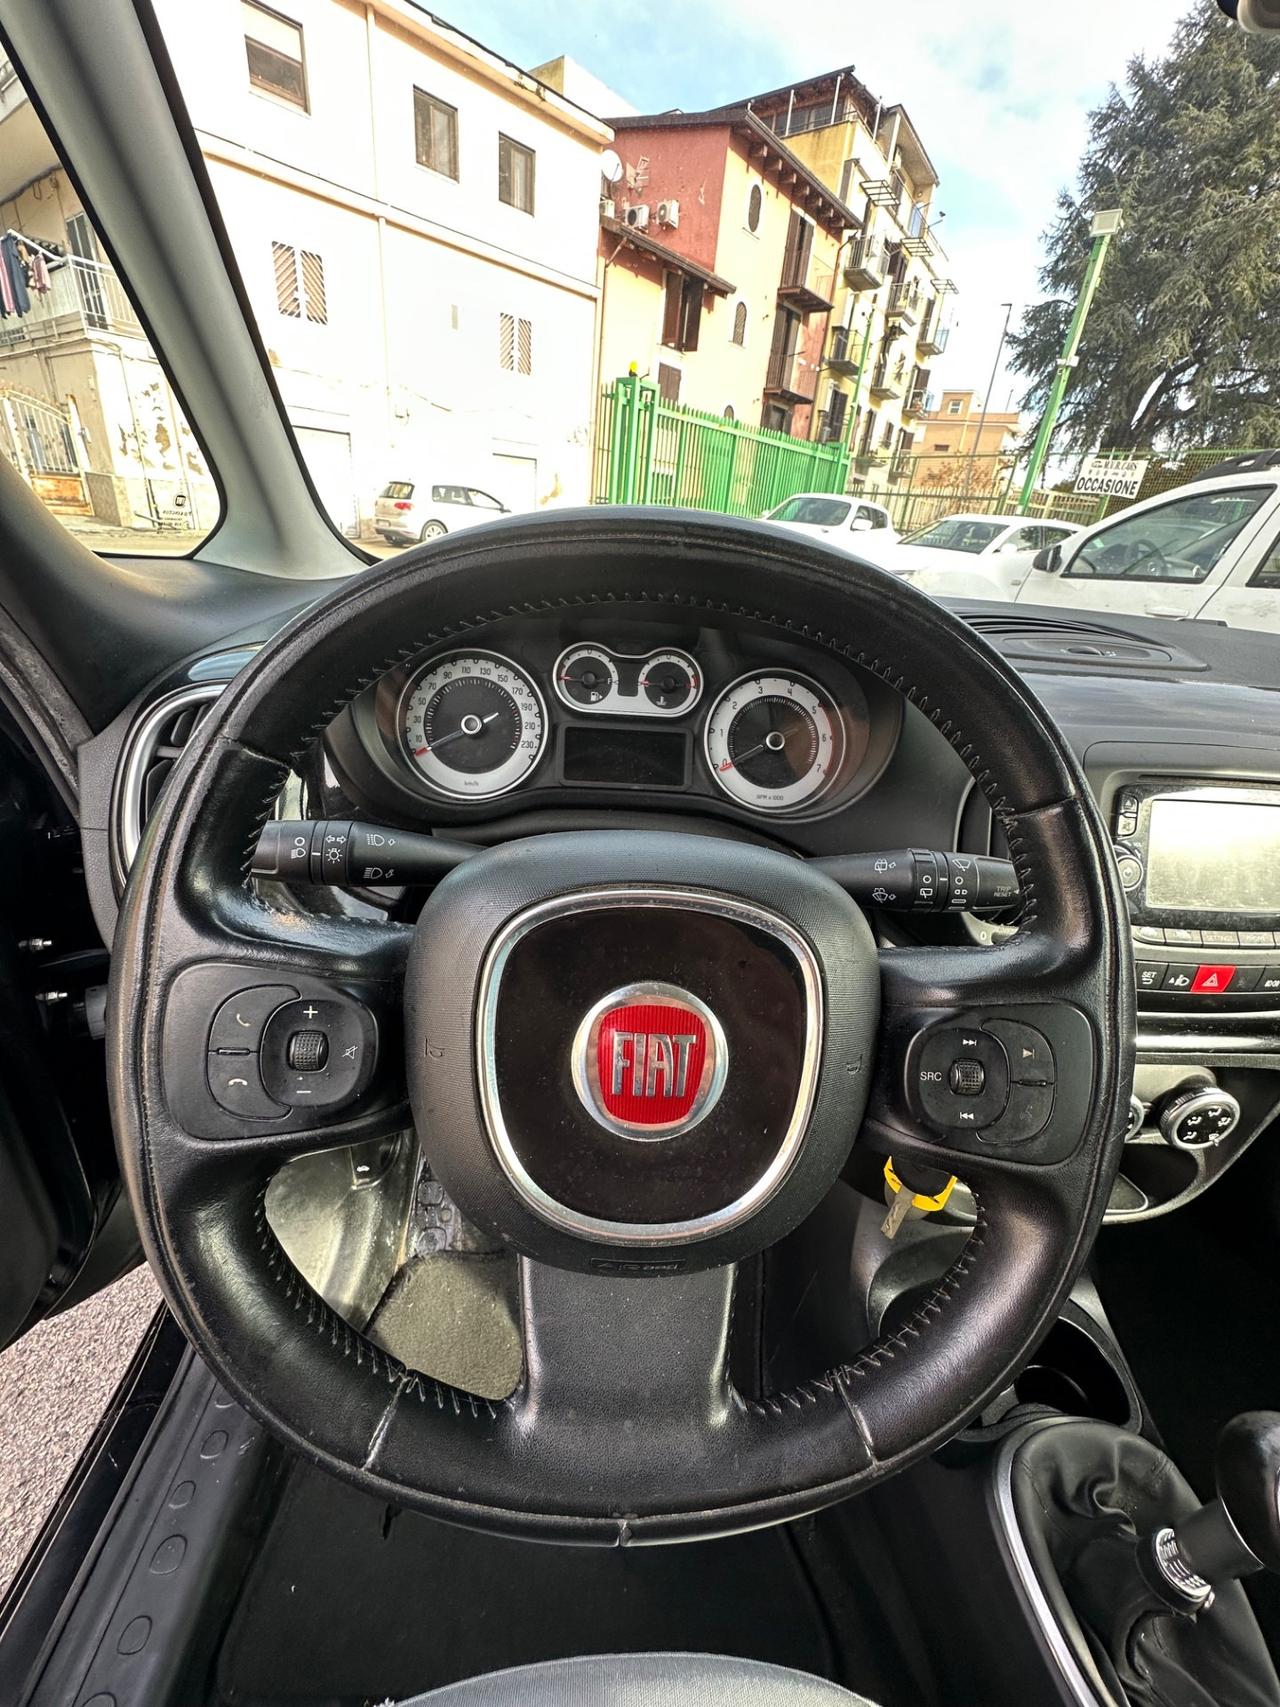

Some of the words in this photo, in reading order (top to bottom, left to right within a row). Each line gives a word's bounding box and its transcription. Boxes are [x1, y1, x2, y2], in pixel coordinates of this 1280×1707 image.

[1077, 477, 1138, 495] OCCASIONE
[461, 666, 471, 674] 110
[480, 667, 492, 676] 130
[443, 671, 452, 679] 90
[497, 674, 508, 682] 150
[428, 682, 437, 690] 70
[512, 687, 523, 696] 170
[758, 686, 763, 695] 3
[787, 687, 793, 696] 4
[418, 697, 427, 705] 50
[521, 703, 533, 711] 190
[732, 701, 737, 710] 2
[811, 706, 816, 715] 5
[413, 716, 422, 724] 30
[524, 722, 535, 730] 210
[415, 735, 423, 743] 10
[821, 734, 827, 743] 6
[521, 741, 534, 749] 230
[816, 764, 822, 773] 7
[1141, 971, 1158, 979] SET
[611, 1030, 697, 1098] FIAT
[920, 1071, 943, 1082] SRC
